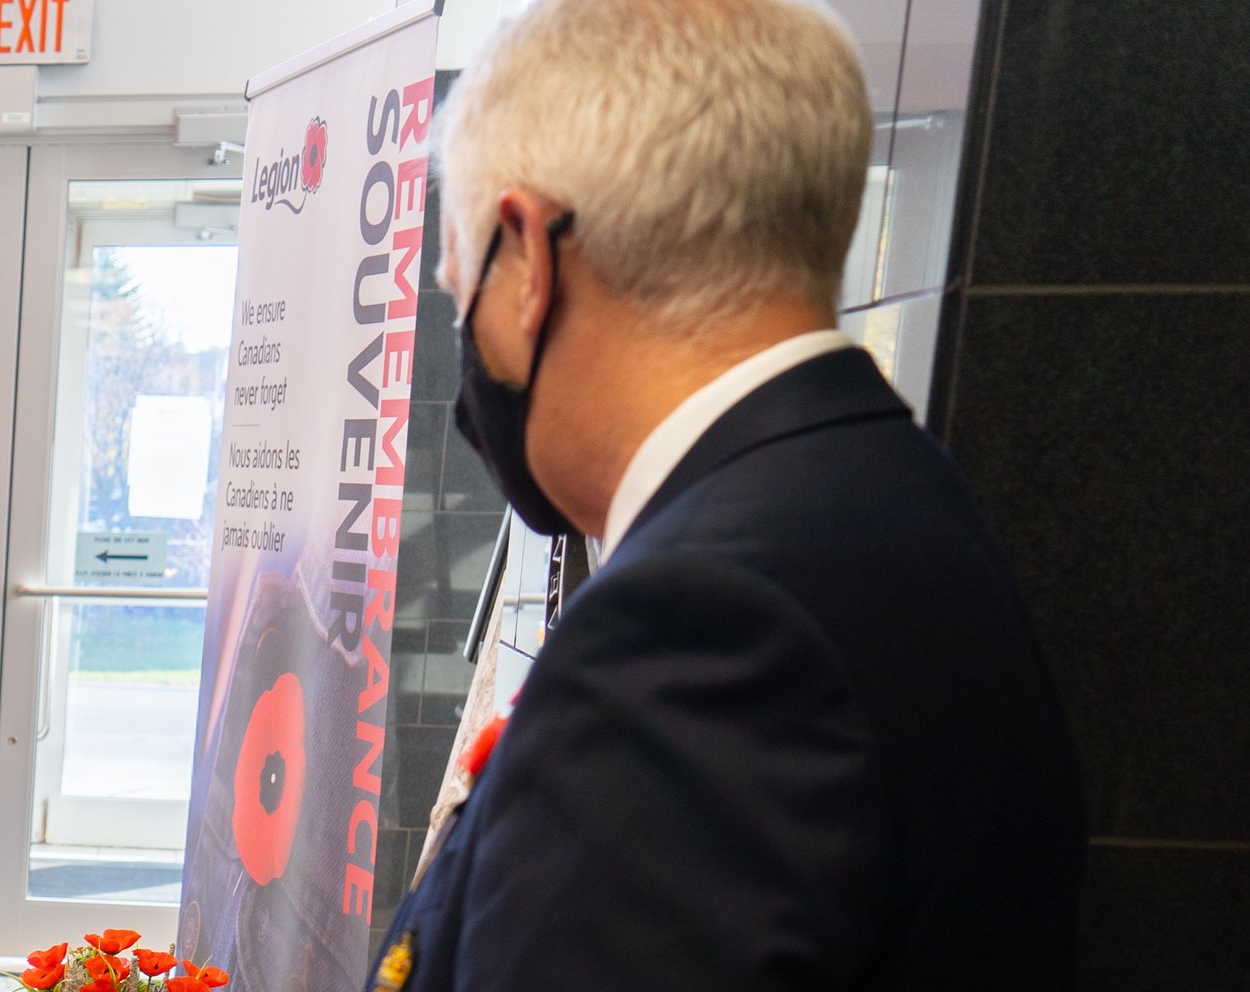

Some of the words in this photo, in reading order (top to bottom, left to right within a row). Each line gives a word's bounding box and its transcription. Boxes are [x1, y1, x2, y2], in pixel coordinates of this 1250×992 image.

[251, 147, 300, 210] Legion
[241, 299, 254, 326] We
[256, 300, 285, 324] ensure
[237, 335, 281, 366] Canadians
[328, 89, 400, 653] SOUVENIR
[234, 384, 259, 406] never
[260, 376, 287, 411] forget
[229, 441, 251, 468] Nous
[252, 440, 283, 469] aidons
[285, 439, 300, 470] les
[226, 480, 269, 510] Canadiens
[271, 482, 278, 510] à
[280, 490, 294, 511] ne
[343, 76, 434, 925] REMEMBRANCE
[221, 520, 250, 551] jamais
[251, 521, 285, 552] oublier
